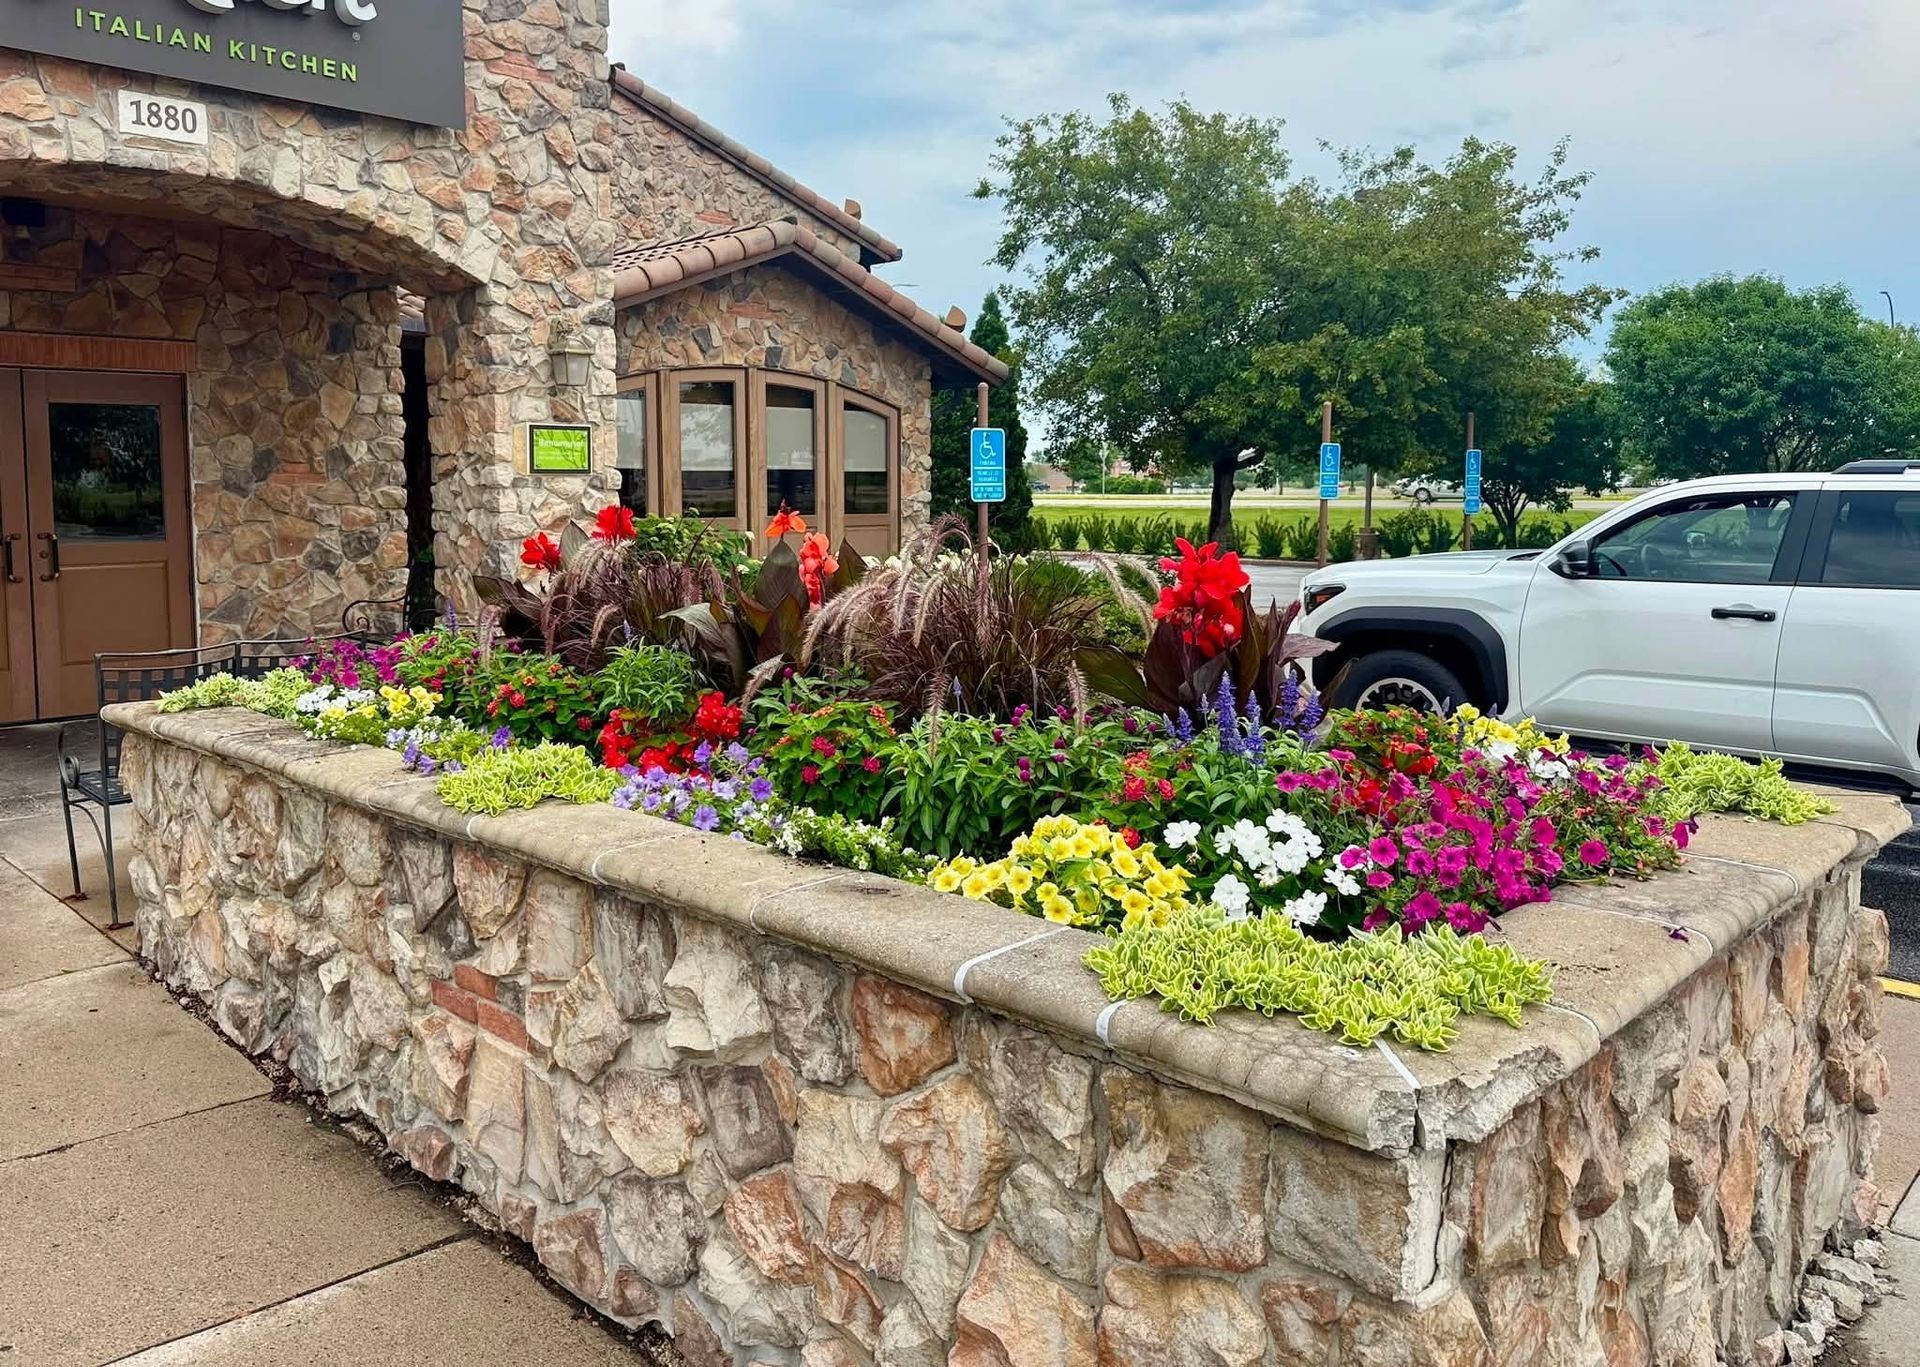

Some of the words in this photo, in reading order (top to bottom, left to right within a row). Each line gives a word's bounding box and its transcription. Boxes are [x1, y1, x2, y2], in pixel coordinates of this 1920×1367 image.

[75, 8, 211, 53] ITALIAN
[229, 40, 357, 82] KITCHEN
[130, 100, 197, 133] 1880
